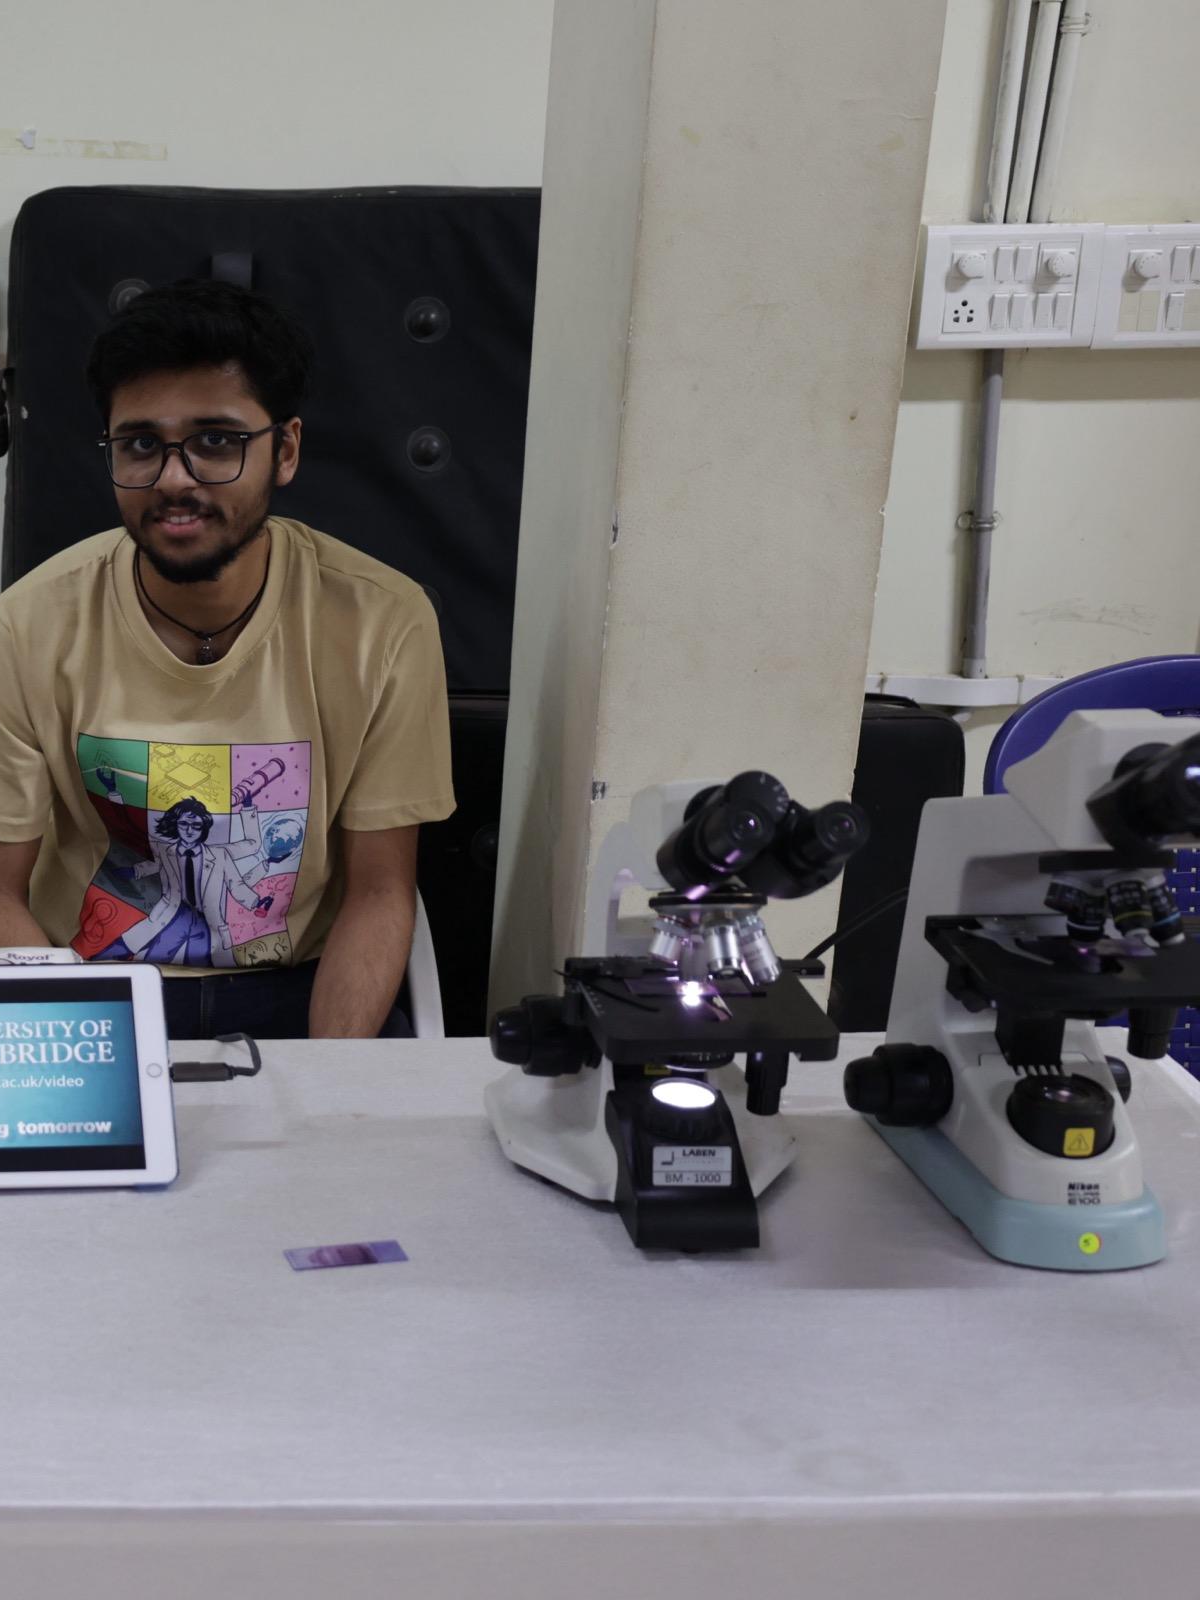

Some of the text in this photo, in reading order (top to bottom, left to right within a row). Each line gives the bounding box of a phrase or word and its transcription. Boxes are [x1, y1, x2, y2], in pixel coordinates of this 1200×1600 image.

[79, 1019, 112, 1037] OF
[17, 1121, 112, 1135] tomorrow
[695, 1173, 721, 1183] 1000
